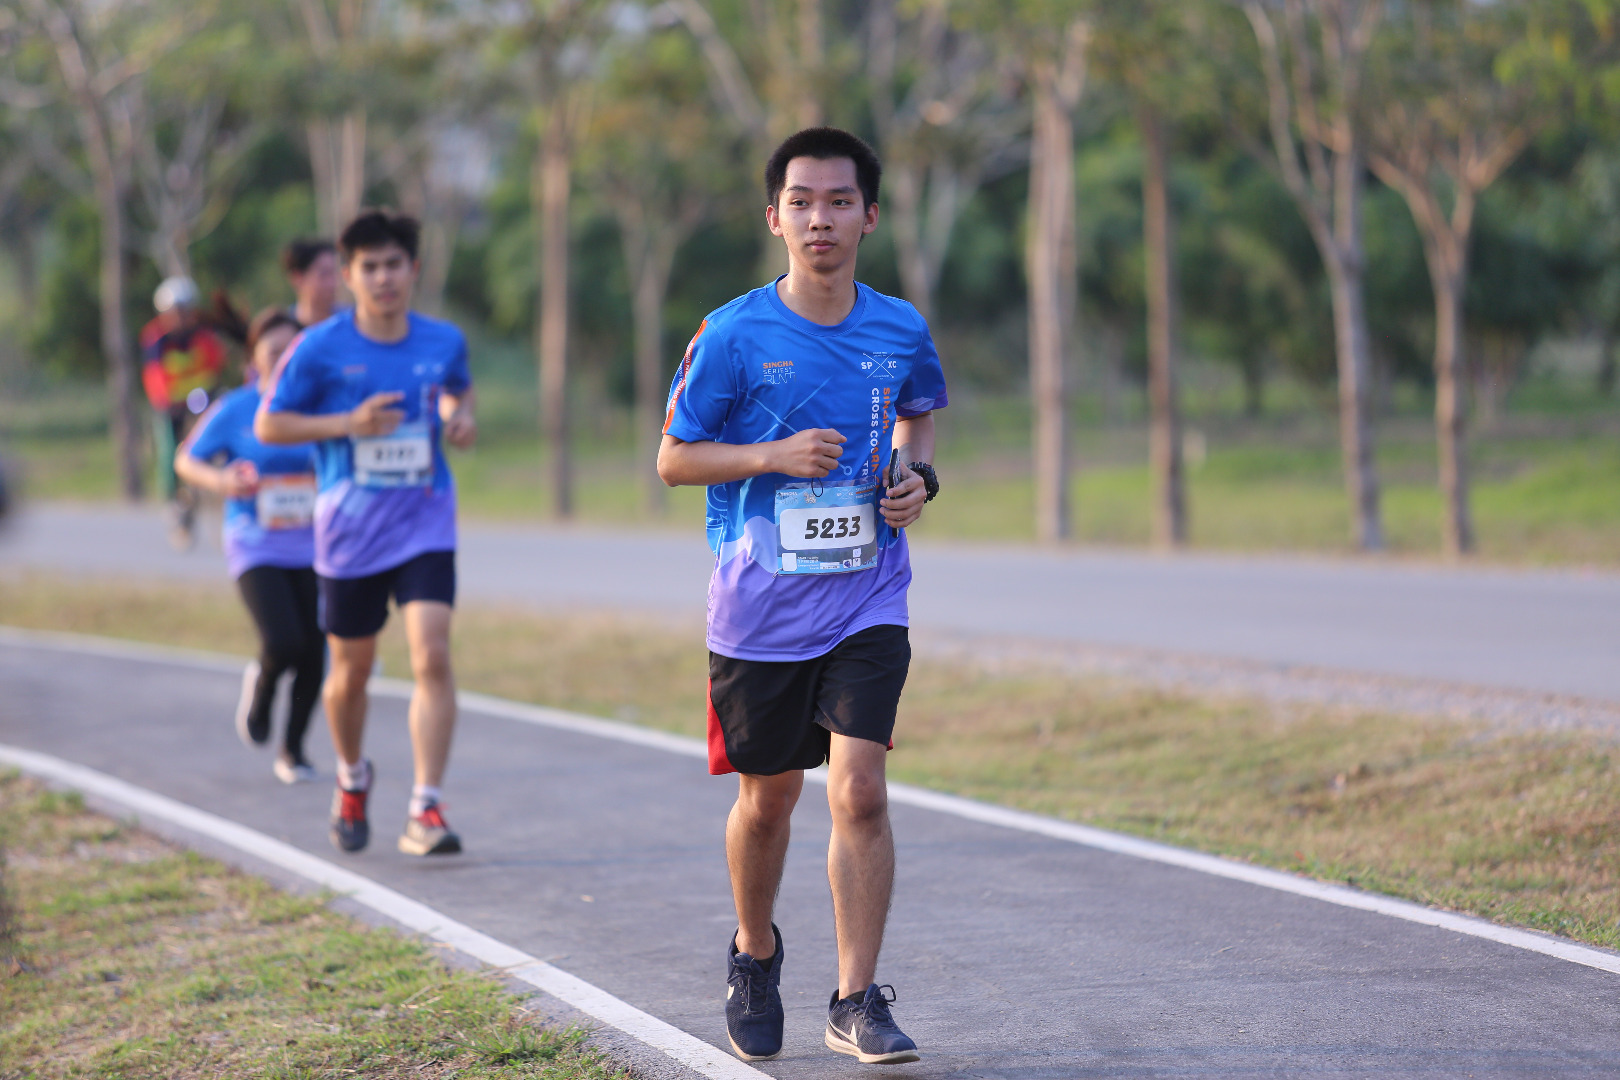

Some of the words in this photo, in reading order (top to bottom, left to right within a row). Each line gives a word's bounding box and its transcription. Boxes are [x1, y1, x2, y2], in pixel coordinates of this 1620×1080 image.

[763, 361, 794, 369] SINGHA
[861, 361, 873, 370] SP
[887, 360, 897, 369] XC
[763, 367, 789, 375] SERIES
[871, 387, 880, 427] CROSS
[804, 516, 861, 539] 5233
